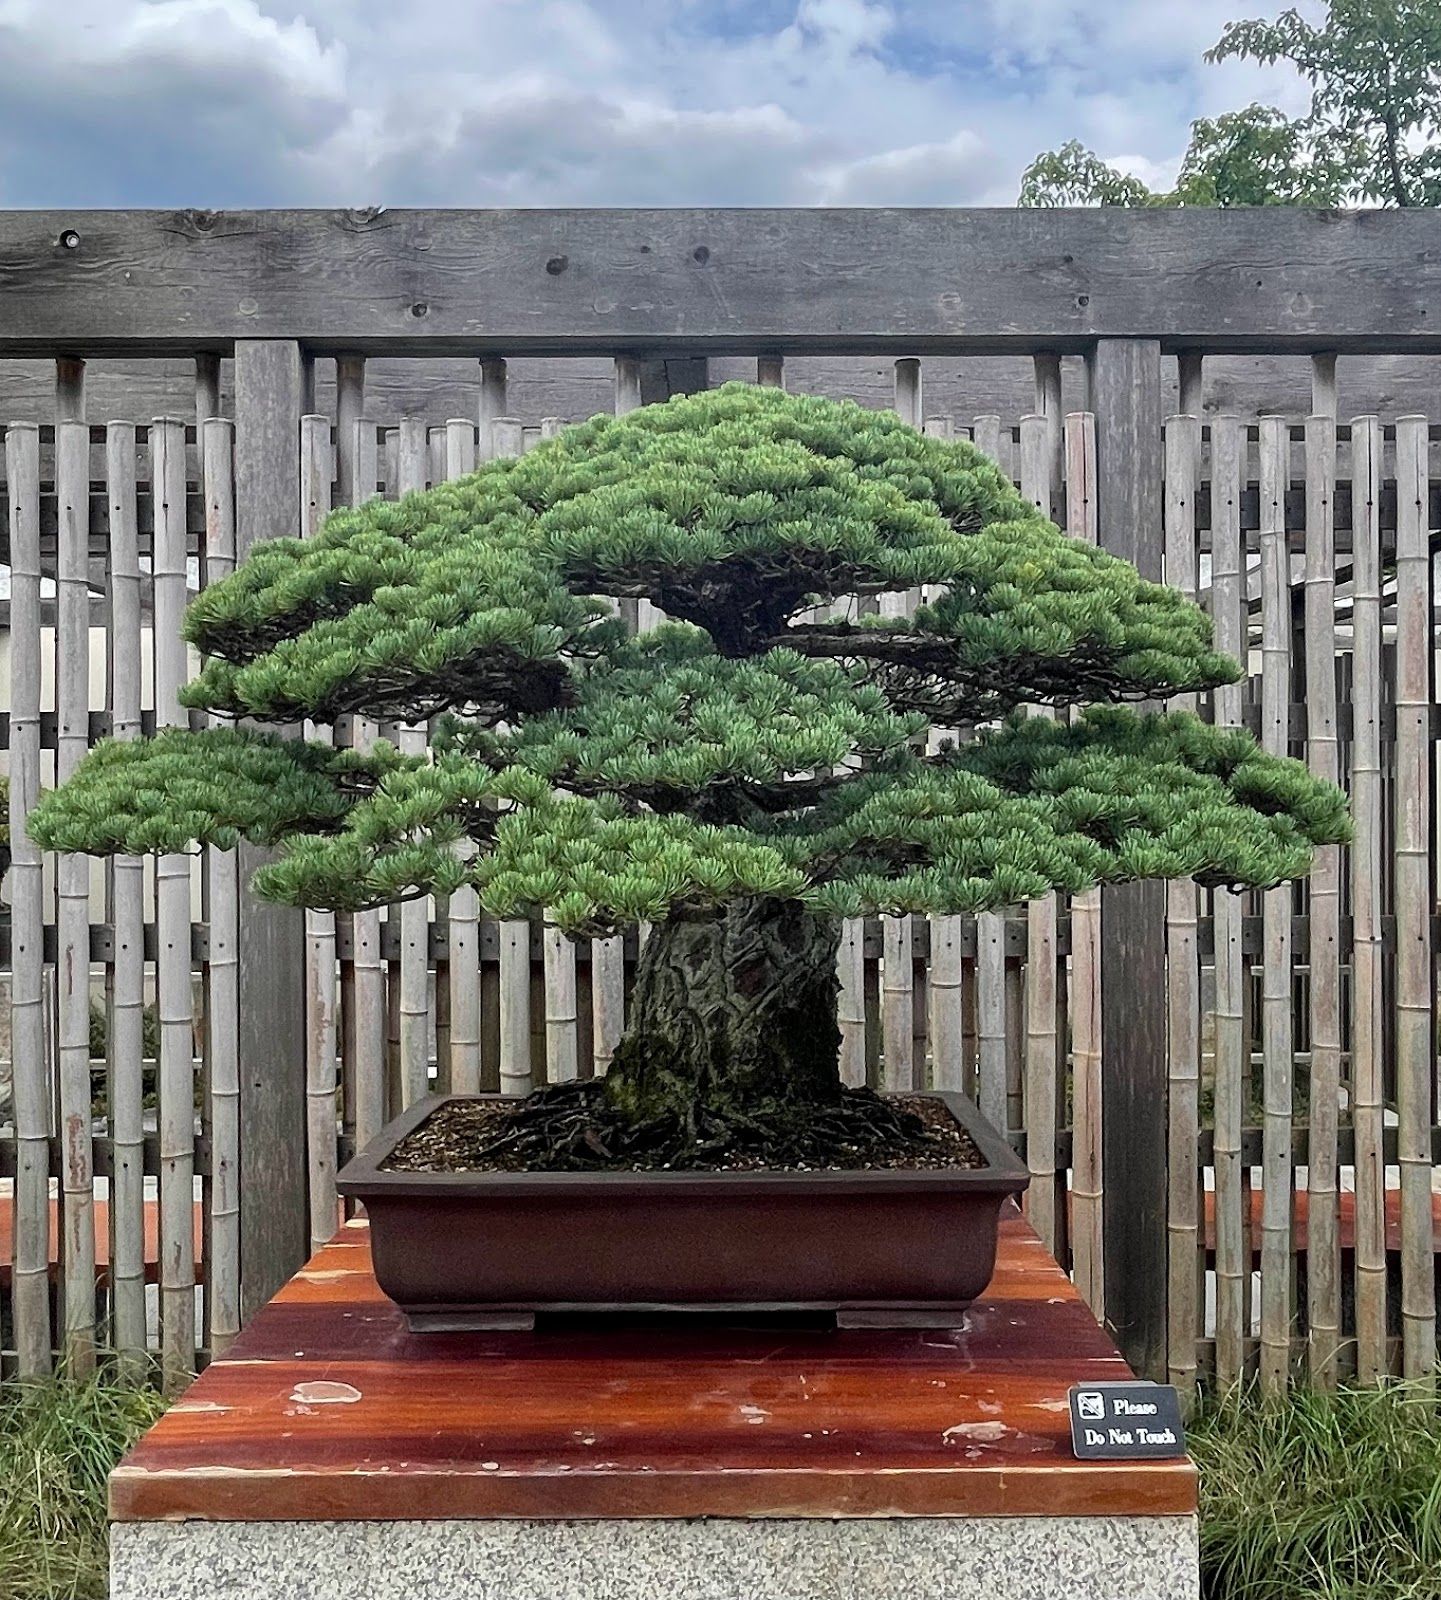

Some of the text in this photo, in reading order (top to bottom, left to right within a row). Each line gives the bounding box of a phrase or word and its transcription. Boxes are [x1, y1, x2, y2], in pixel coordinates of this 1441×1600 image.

[1113, 1399, 1157, 1415] Please
[1085, 1428, 1176, 1445] Do Not Touch
